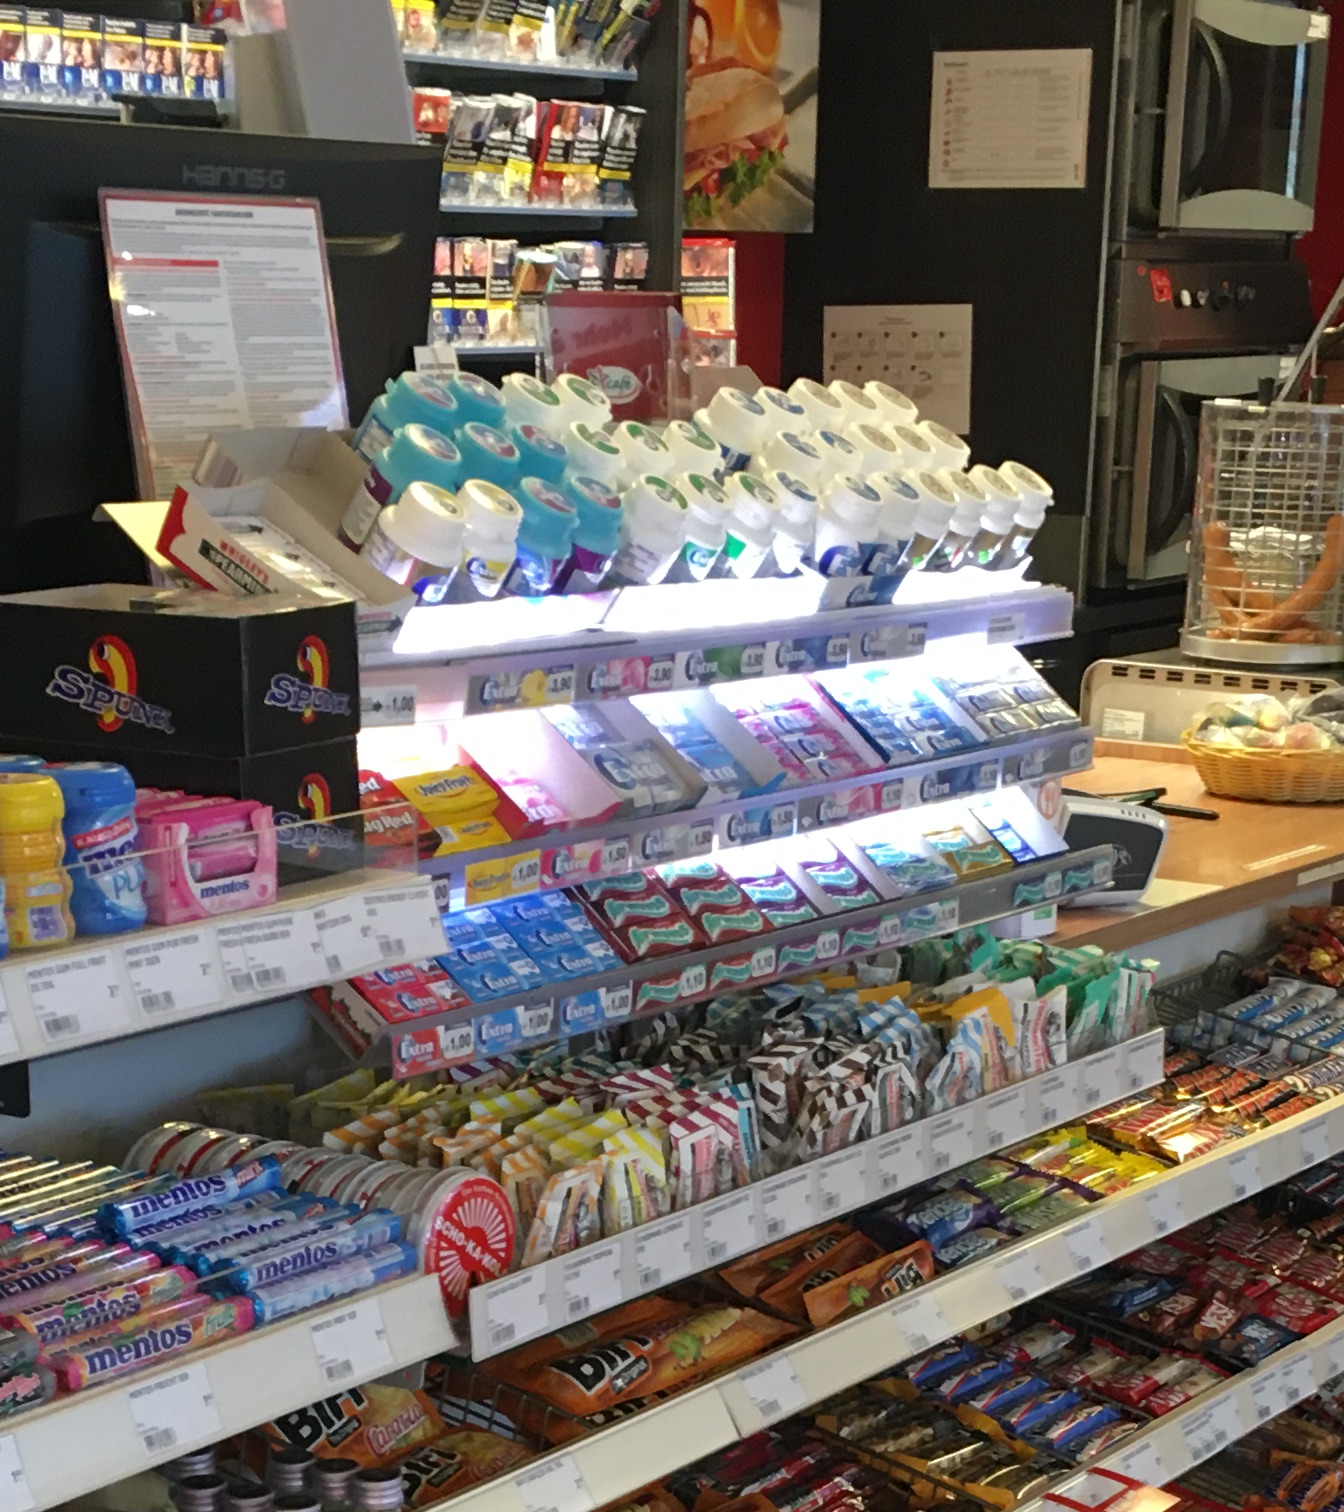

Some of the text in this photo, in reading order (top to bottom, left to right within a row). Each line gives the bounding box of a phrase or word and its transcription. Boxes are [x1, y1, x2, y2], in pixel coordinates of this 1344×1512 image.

[46, 664, 176, 734] SPUNK
[200, 879, 250, 900] mentos
[398, 1039, 435, 1064] Extra
[478, 1021, 513, 1045] Extra
[131, 1173, 226, 1219] mentos
[256, 1240, 338, 1282] mentos
[435, 1215, 503, 1275] SCHO-KA-KOL
[85, 1323, 193, 1374] mentos
